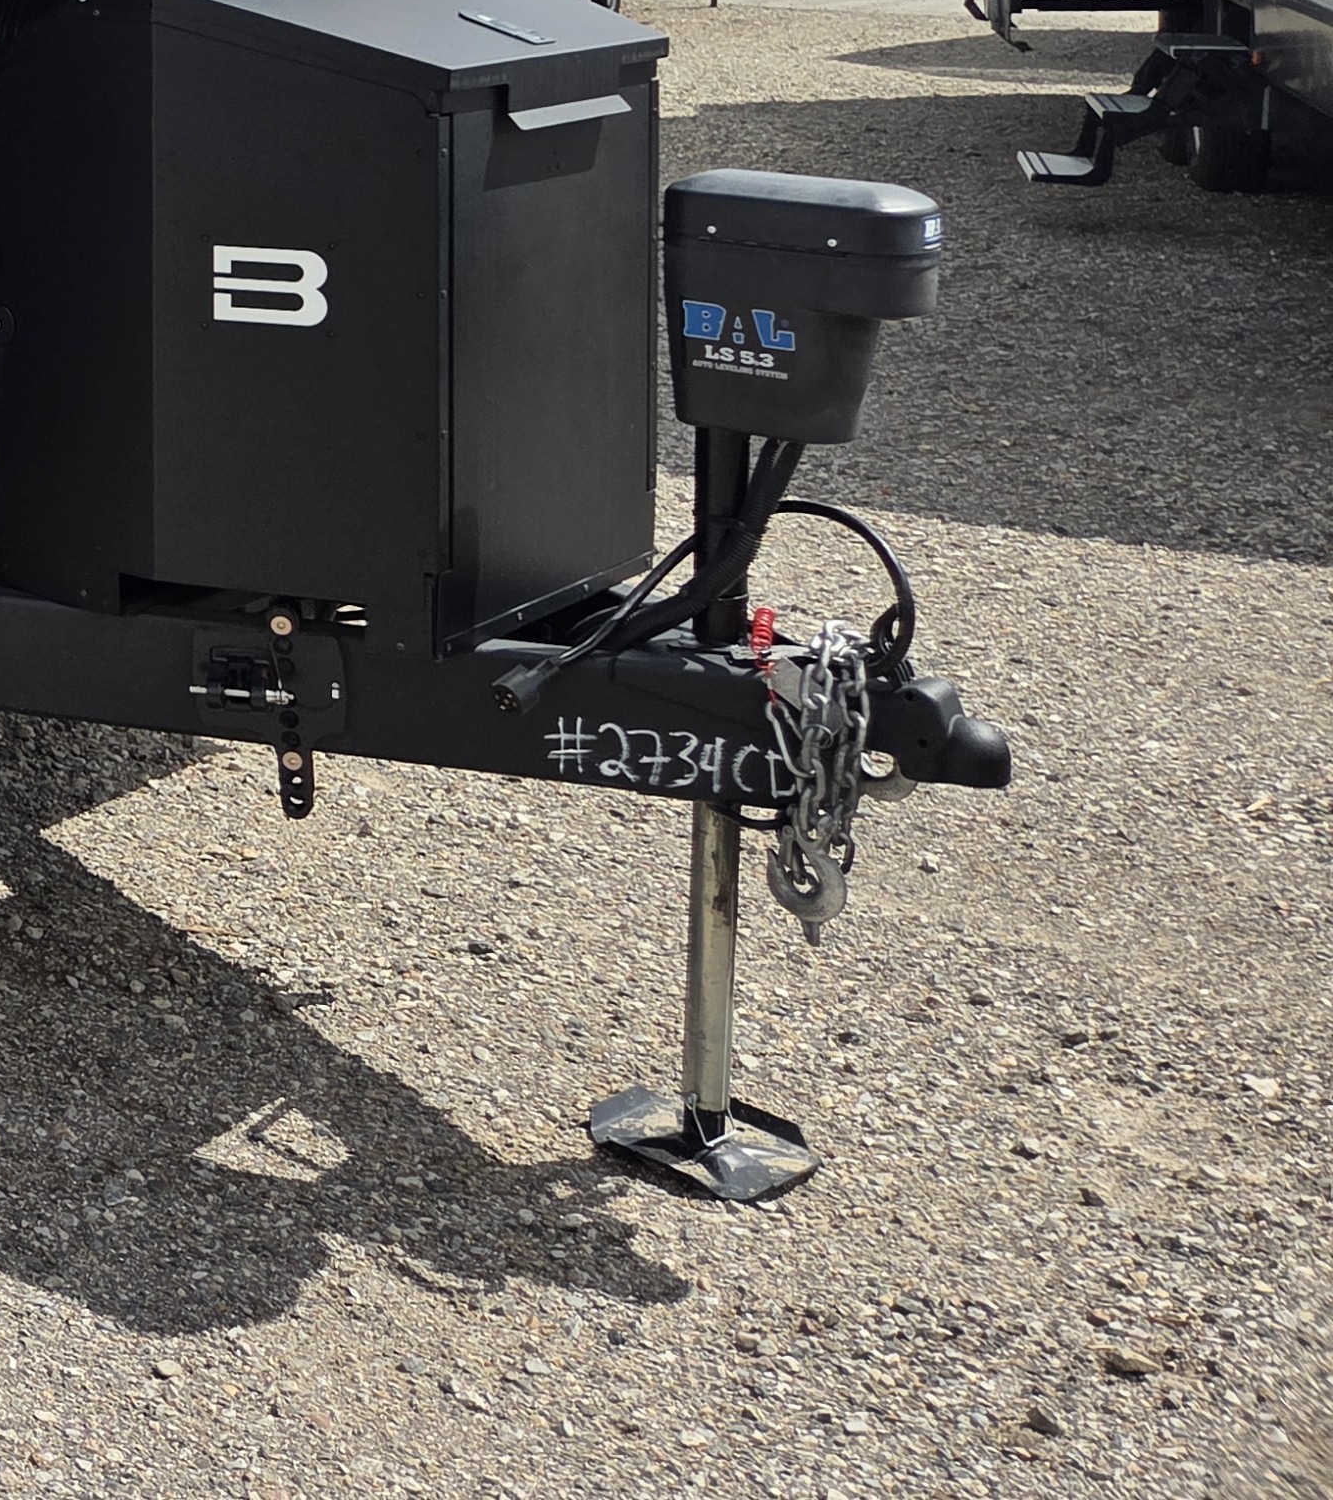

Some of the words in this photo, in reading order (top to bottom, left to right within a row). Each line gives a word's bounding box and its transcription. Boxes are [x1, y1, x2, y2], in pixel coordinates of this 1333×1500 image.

[213, 245, 329, 327] B
[682, 299, 796, 351] BAL
[704, 344, 735, 362] LS
[740, 350, 774, 368] 5.3
